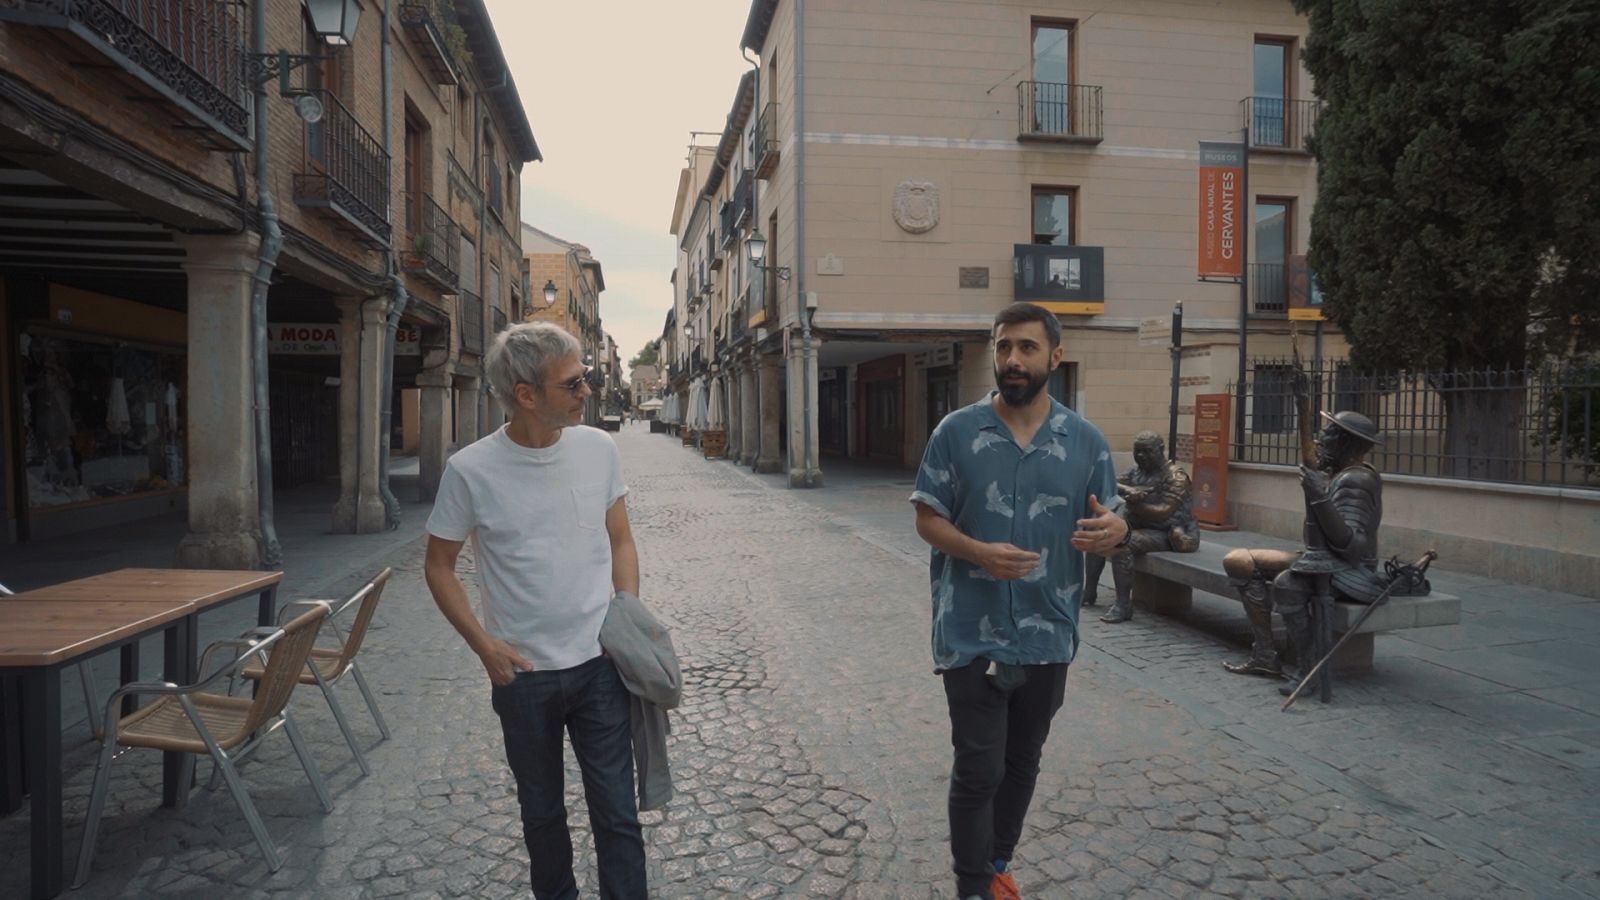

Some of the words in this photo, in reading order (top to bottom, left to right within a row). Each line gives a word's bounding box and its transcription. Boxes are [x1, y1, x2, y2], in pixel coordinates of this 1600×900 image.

[1204, 153, 1237, 161] MUSEOS
[1207, 210, 1215, 231] CASA
[1222, 171, 1234, 259] CERVANTES
[281, 328, 336, 341] MODA
